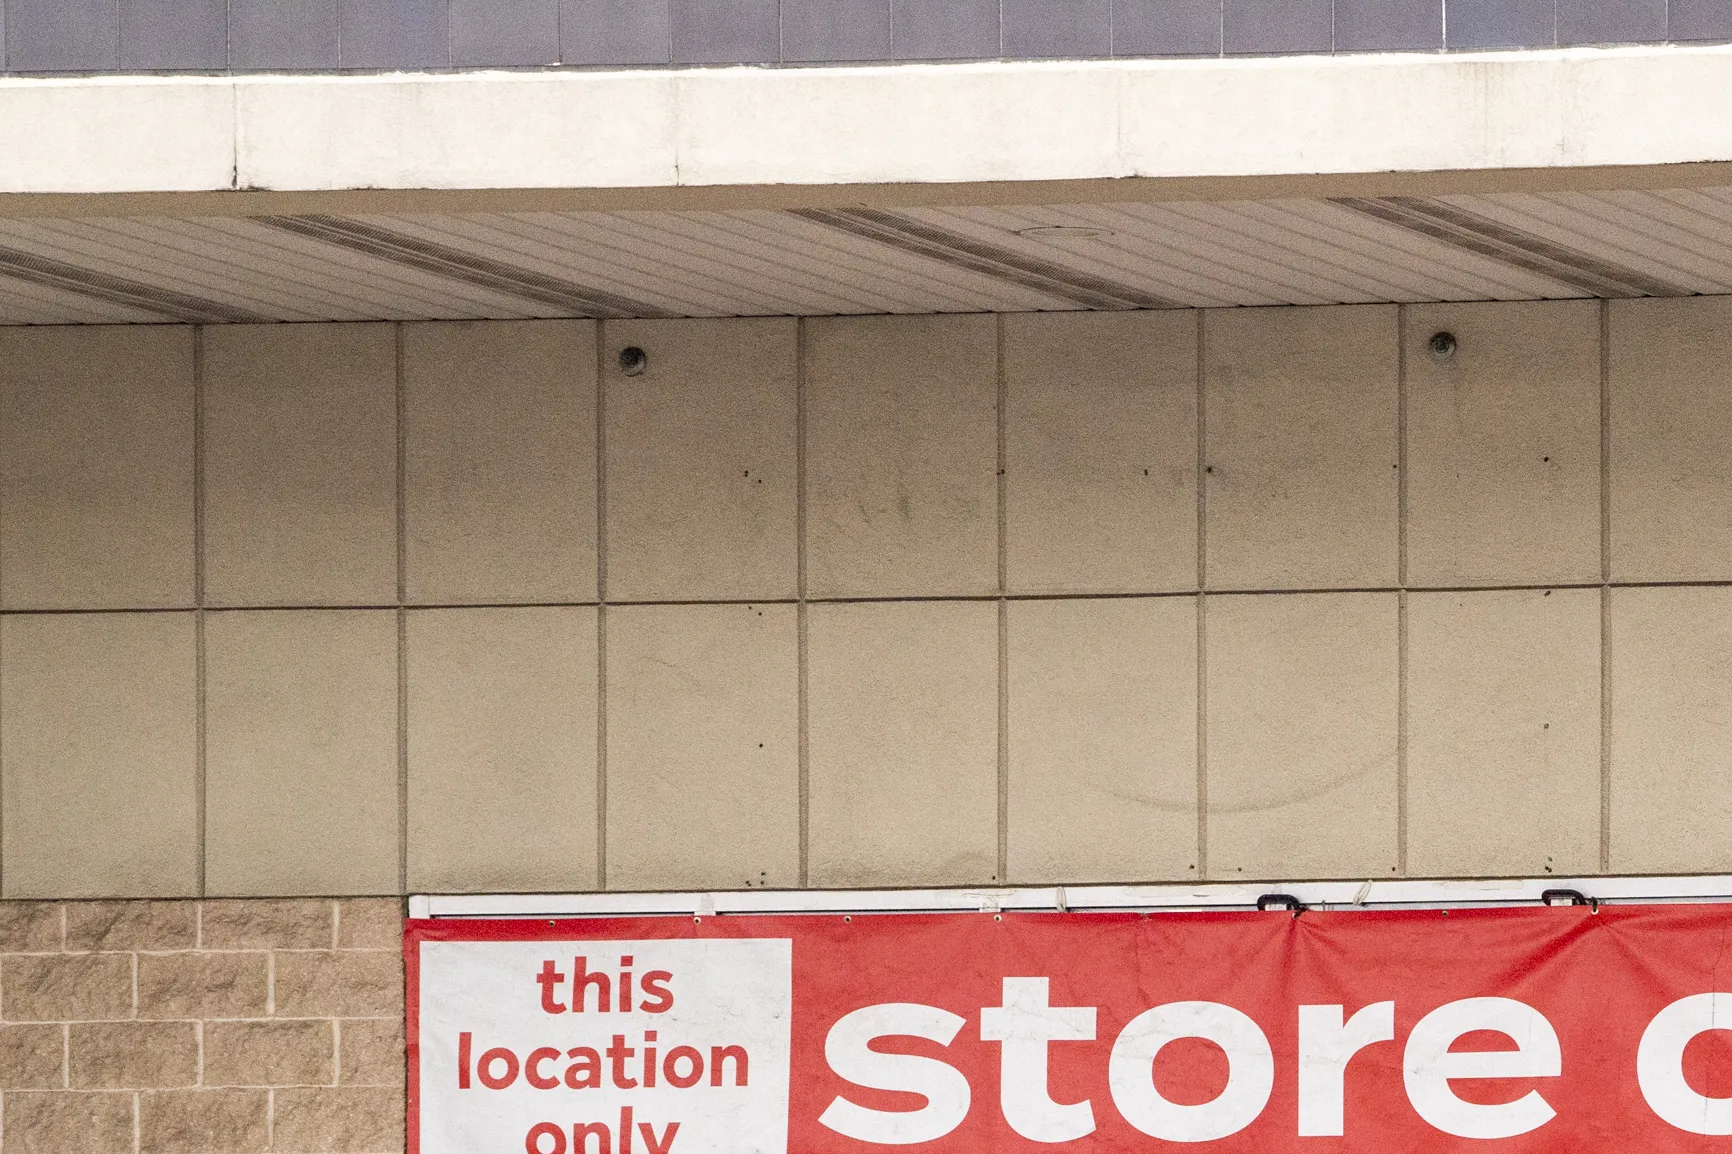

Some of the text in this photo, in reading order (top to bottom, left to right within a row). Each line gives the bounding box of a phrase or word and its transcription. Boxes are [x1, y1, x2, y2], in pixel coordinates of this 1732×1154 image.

[536, 955, 674, 1014] this
[458, 1031, 749, 1090] location
[817, 976, 1562, 1145] store
